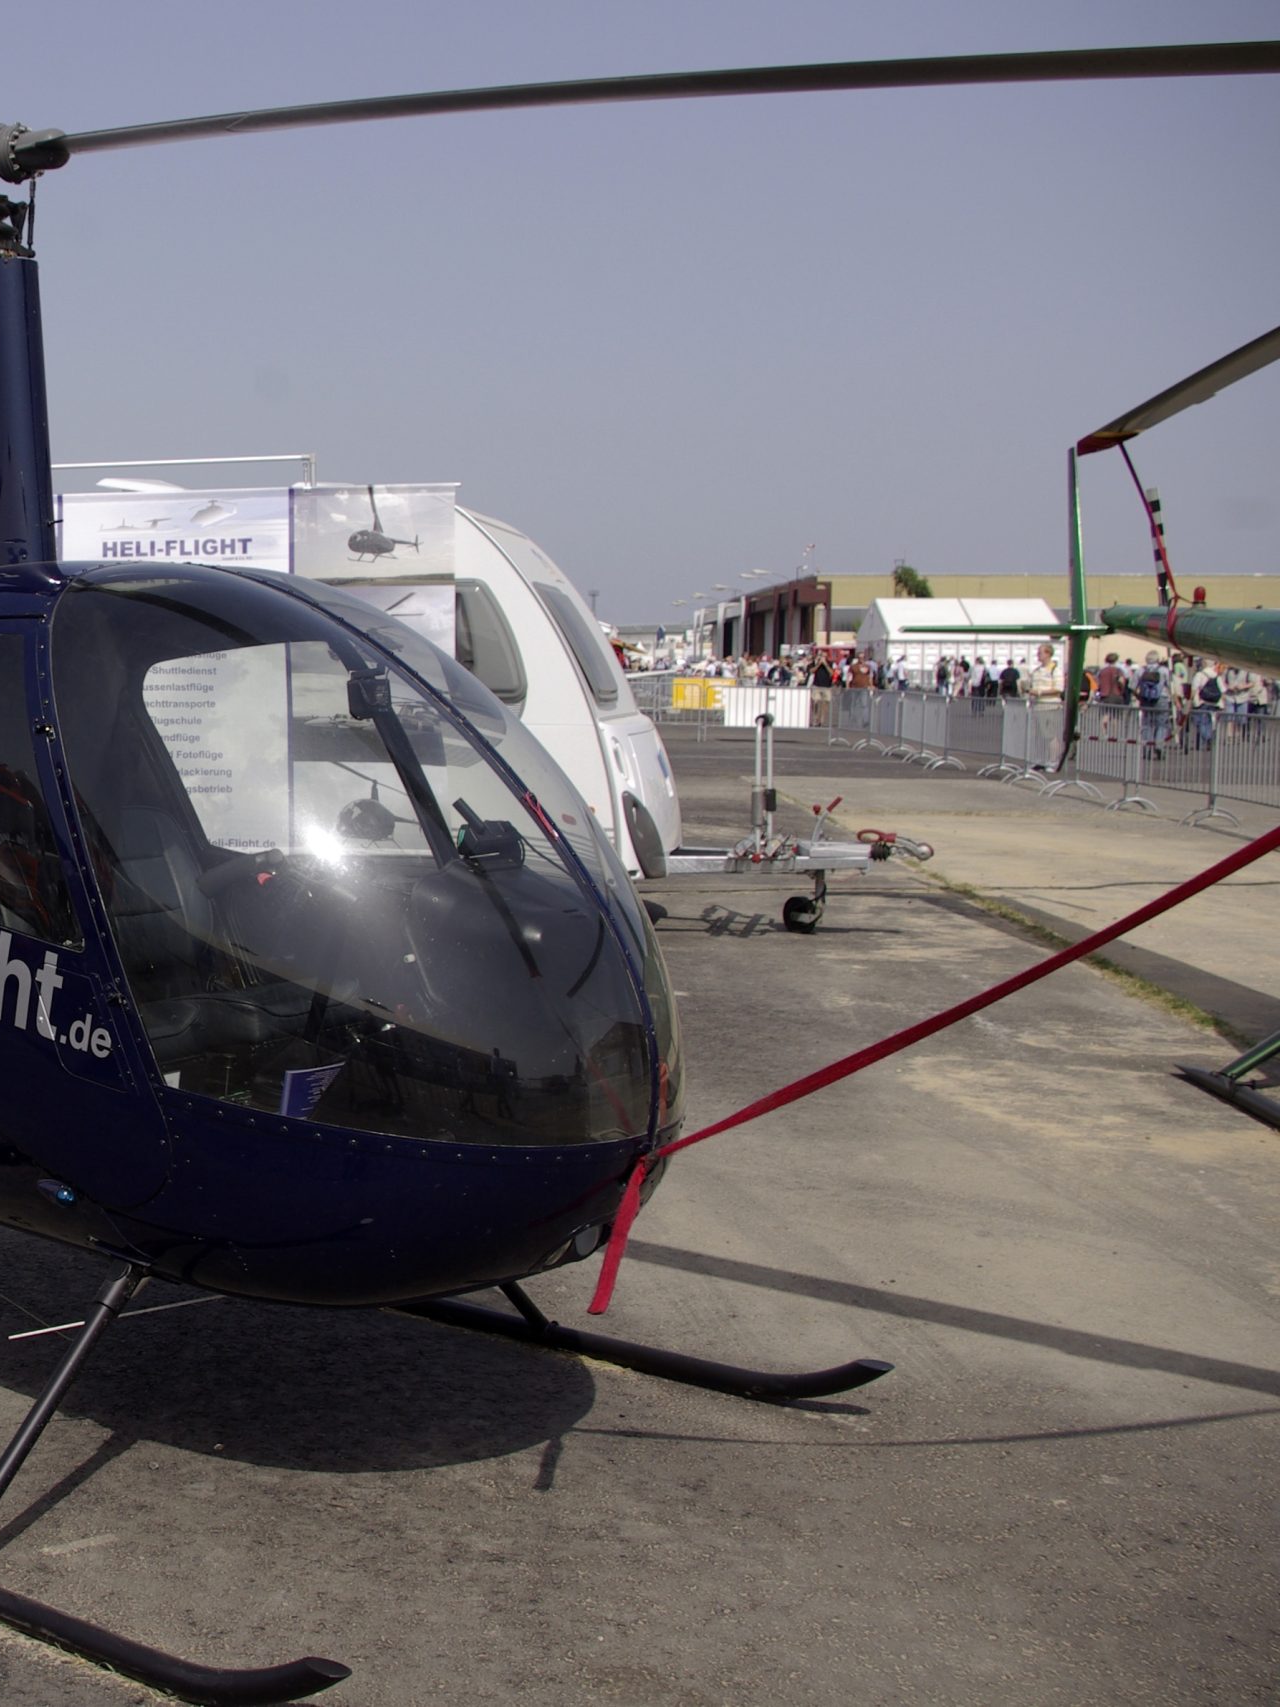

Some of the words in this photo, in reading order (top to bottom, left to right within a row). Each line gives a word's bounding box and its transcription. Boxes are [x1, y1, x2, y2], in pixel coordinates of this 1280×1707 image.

[102, 538, 253, 558] HELI-FLIGHT
[148, 666, 217, 676] -Shuttledienst
[143, 683, 214, 693] ussenlastflüge
[176, 750, 224, 761] Fotoflüge
